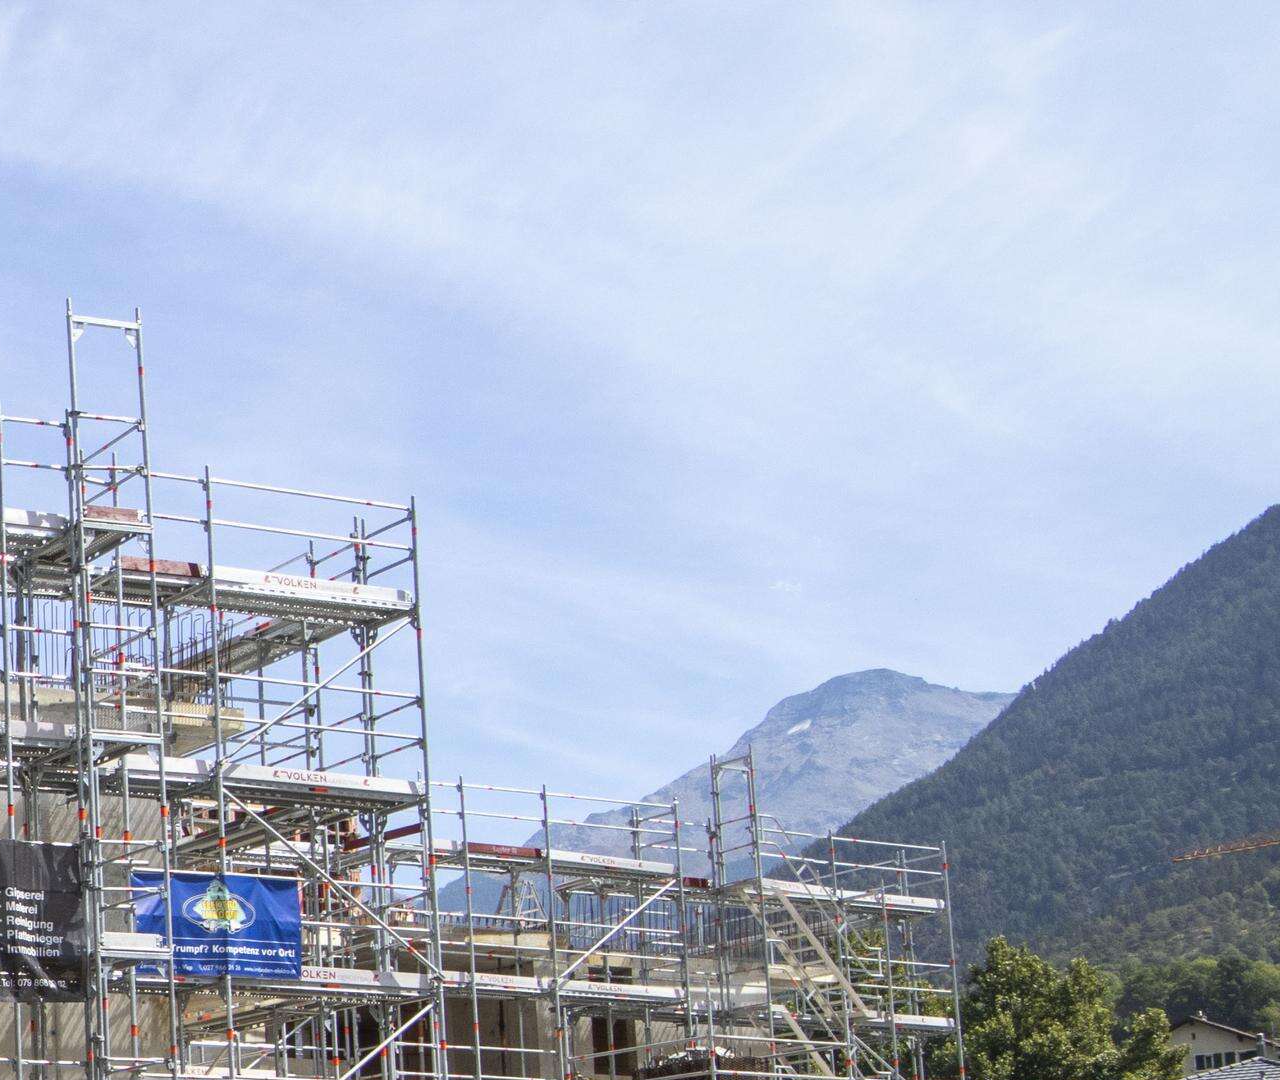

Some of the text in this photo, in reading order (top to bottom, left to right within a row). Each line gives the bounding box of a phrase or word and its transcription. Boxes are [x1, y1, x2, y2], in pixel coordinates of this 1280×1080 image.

[277, 577, 317, 590] VOLKEN
[287, 771, 327, 783] VOLKEN
[5, 887, 44, 900] Gipserei
[5, 901, 38, 914] Malerei
[6, 915, 54, 930] Reinigung
[6, 930, 64, 945] Plattenleger
[7, 944, 60, 957] Immobilien
[212, 945, 259, 957] Kompetenz
[261, 949, 276, 957] vor
[302, 970, 336, 979] OLKEN
